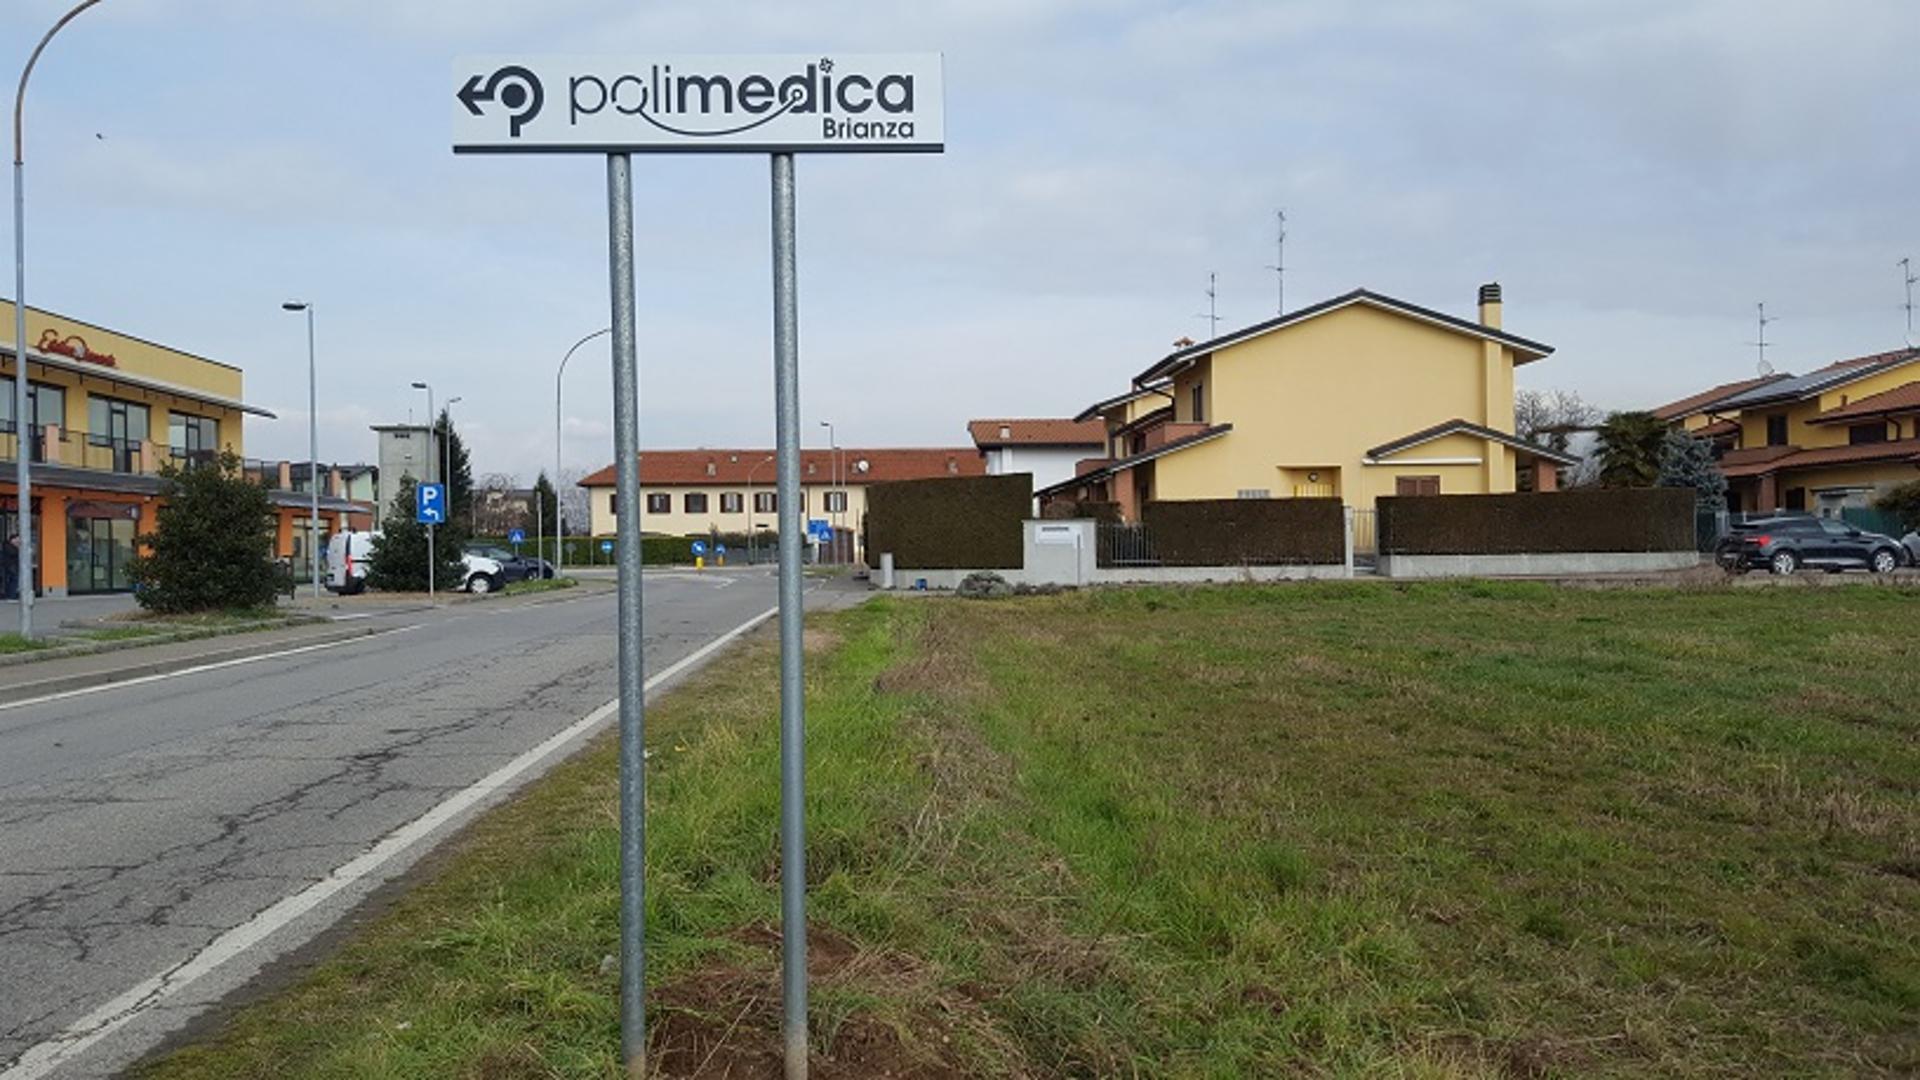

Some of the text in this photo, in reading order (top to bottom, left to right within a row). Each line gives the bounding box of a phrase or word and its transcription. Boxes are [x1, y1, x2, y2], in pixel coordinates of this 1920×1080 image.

[569, 58, 914, 127] polimedica
[823, 117, 914, 139] Brianza
[423, 486, 438, 505] P
